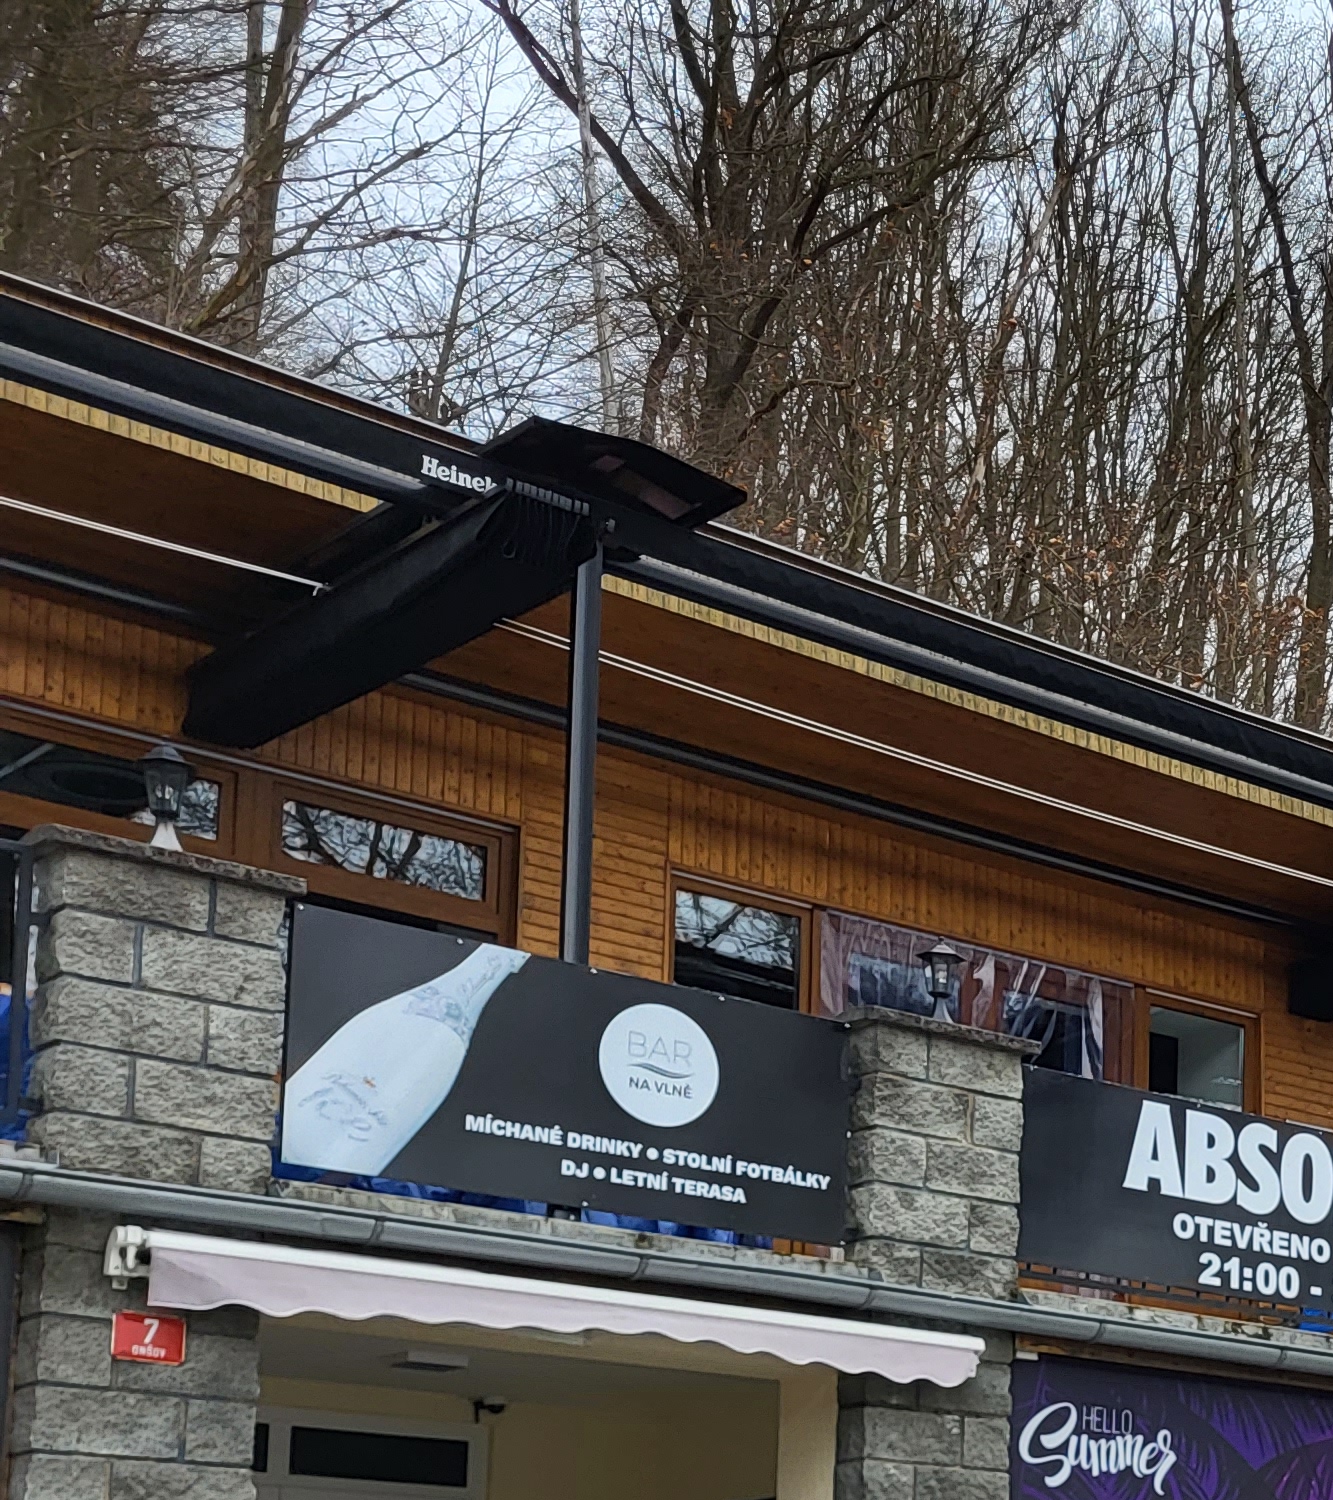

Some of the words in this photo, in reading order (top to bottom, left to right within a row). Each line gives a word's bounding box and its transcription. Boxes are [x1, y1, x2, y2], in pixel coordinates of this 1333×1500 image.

[627, 1029, 692, 1065] BAR
[629, 1076, 651, 1093] NA
[653, 1076, 693, 1100] VLNĚ
[465, 1113, 563, 1146] MÍCHANÉ
[566, 1131, 642, 1160] DRINKY
[662, 1146, 732, 1176] STOLNÍ
[735, 1158, 831, 1191] FOTBÁLKY
[560, 1158, 589, 1180] DJ
[610, 1166, 669, 1193] LETNÍ
[671, 1177, 747, 1205] TERASA
[1172, 1212, 1331, 1265] OTEVŘENO
[1197, 1252, 1300, 1300] 21:00
[143, 1317, 160, 1344] 7
[1082, 1404, 1133, 1435] HELLO
[1018, 1401, 1178, 1496] Summer
